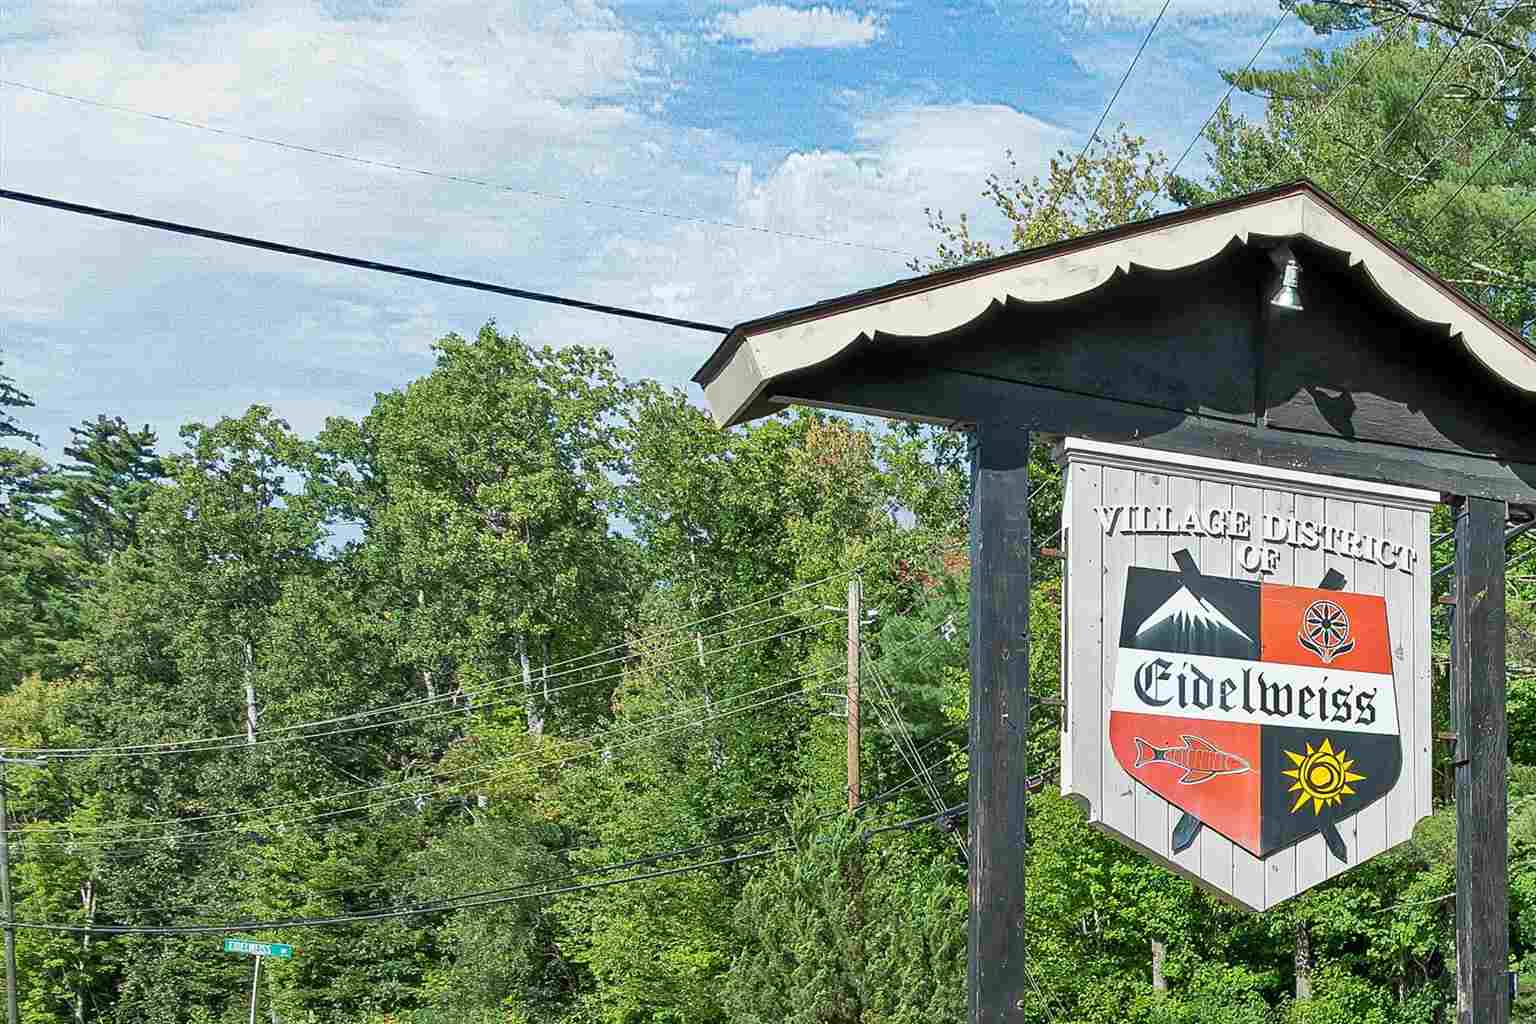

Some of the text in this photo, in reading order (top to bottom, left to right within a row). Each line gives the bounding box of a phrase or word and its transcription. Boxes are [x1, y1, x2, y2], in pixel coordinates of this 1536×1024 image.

[1093, 503, 1418, 575] VILLAGE DISTRICT
[1240, 543, 1281, 576] OF
